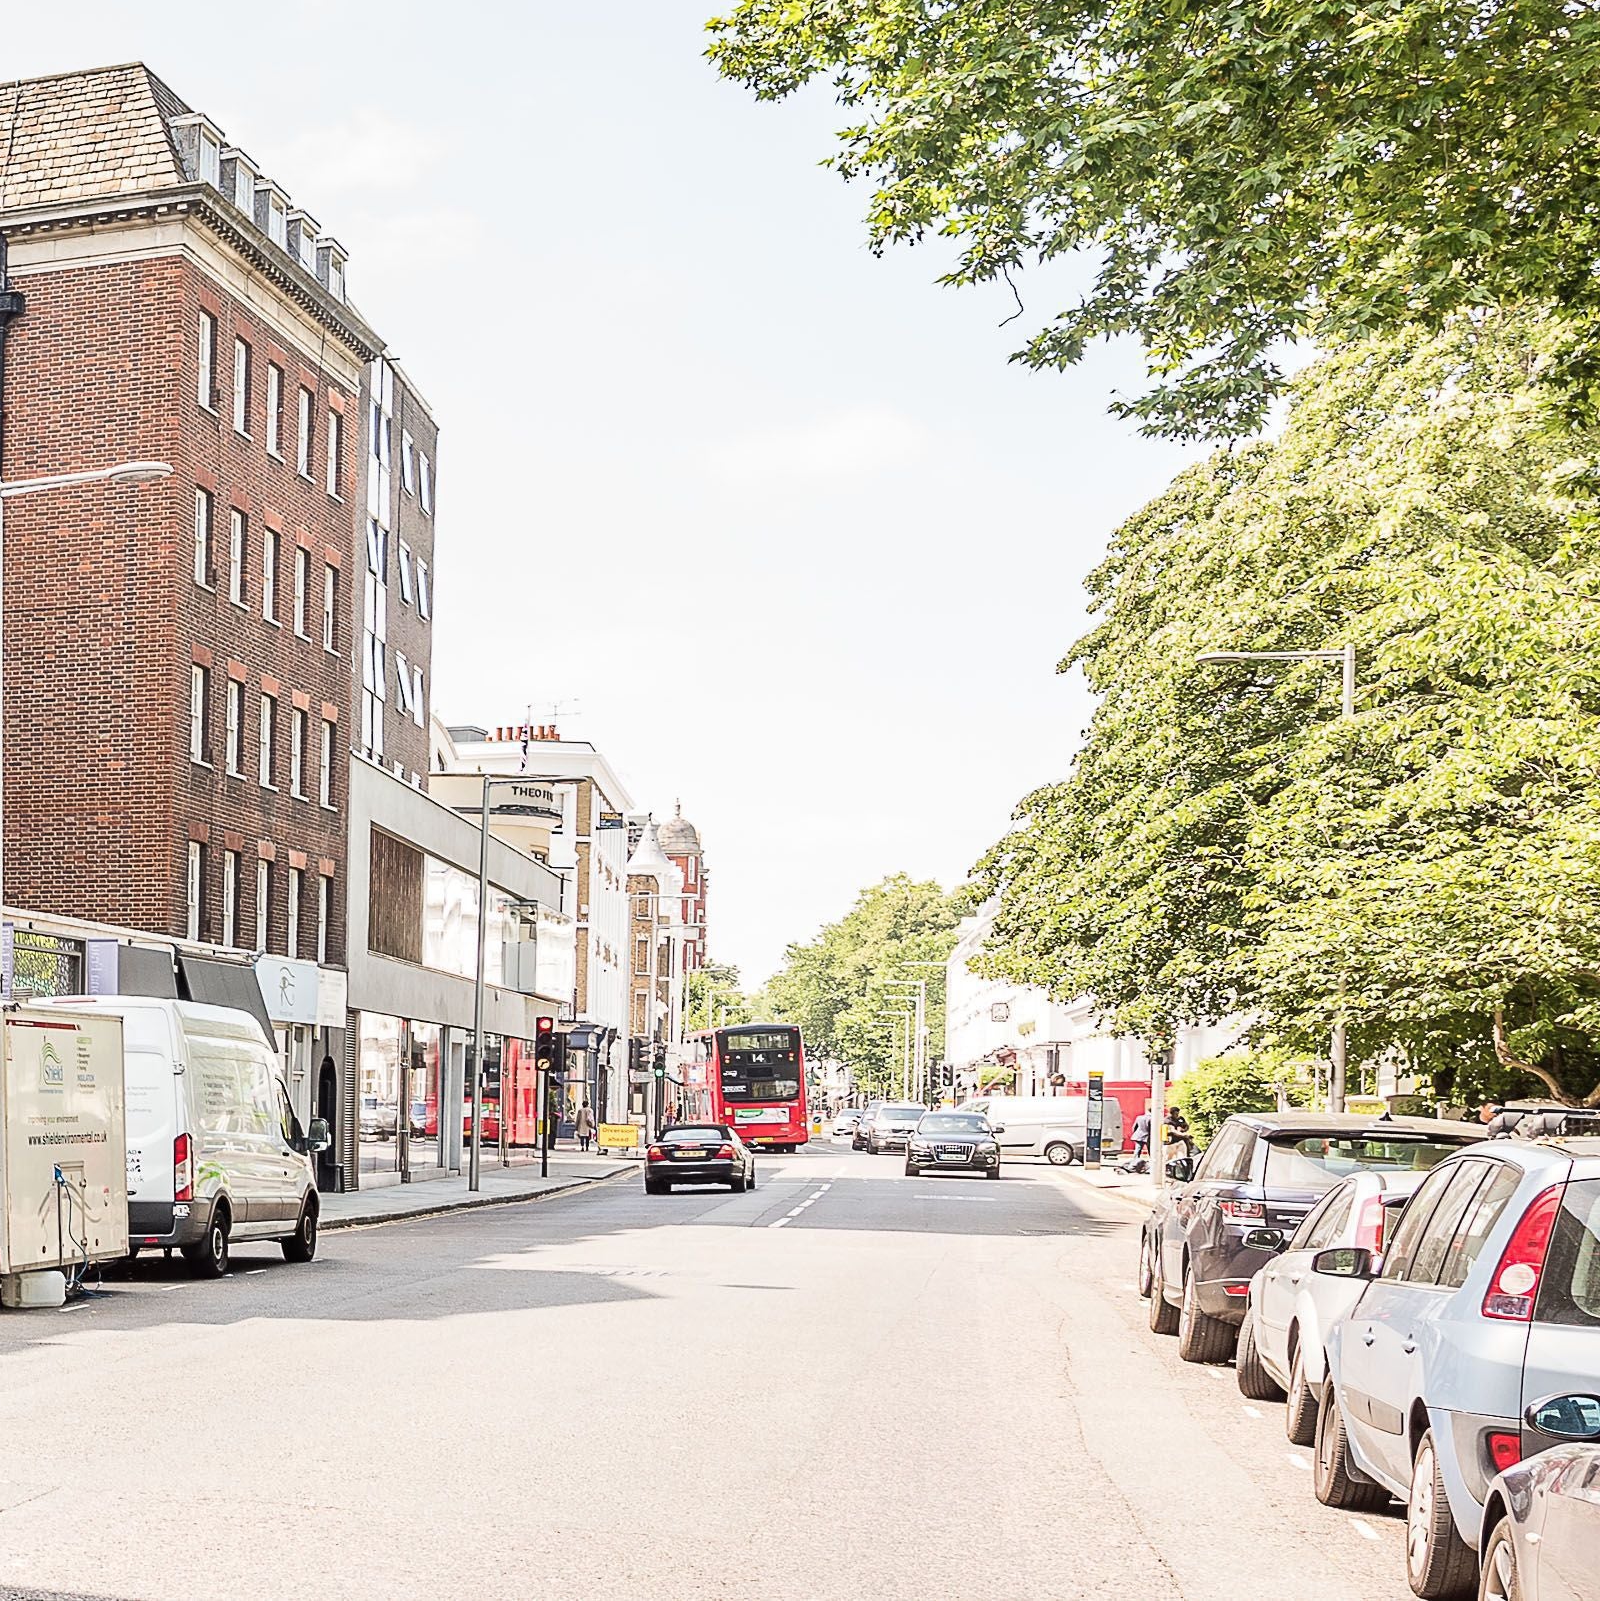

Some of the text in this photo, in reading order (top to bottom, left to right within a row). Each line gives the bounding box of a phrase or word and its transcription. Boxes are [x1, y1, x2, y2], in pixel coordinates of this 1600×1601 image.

[512, 786, 541, 798] THEO
[752, 1053, 765, 1063] 14
[44, 1065, 63, 1081] Shield
